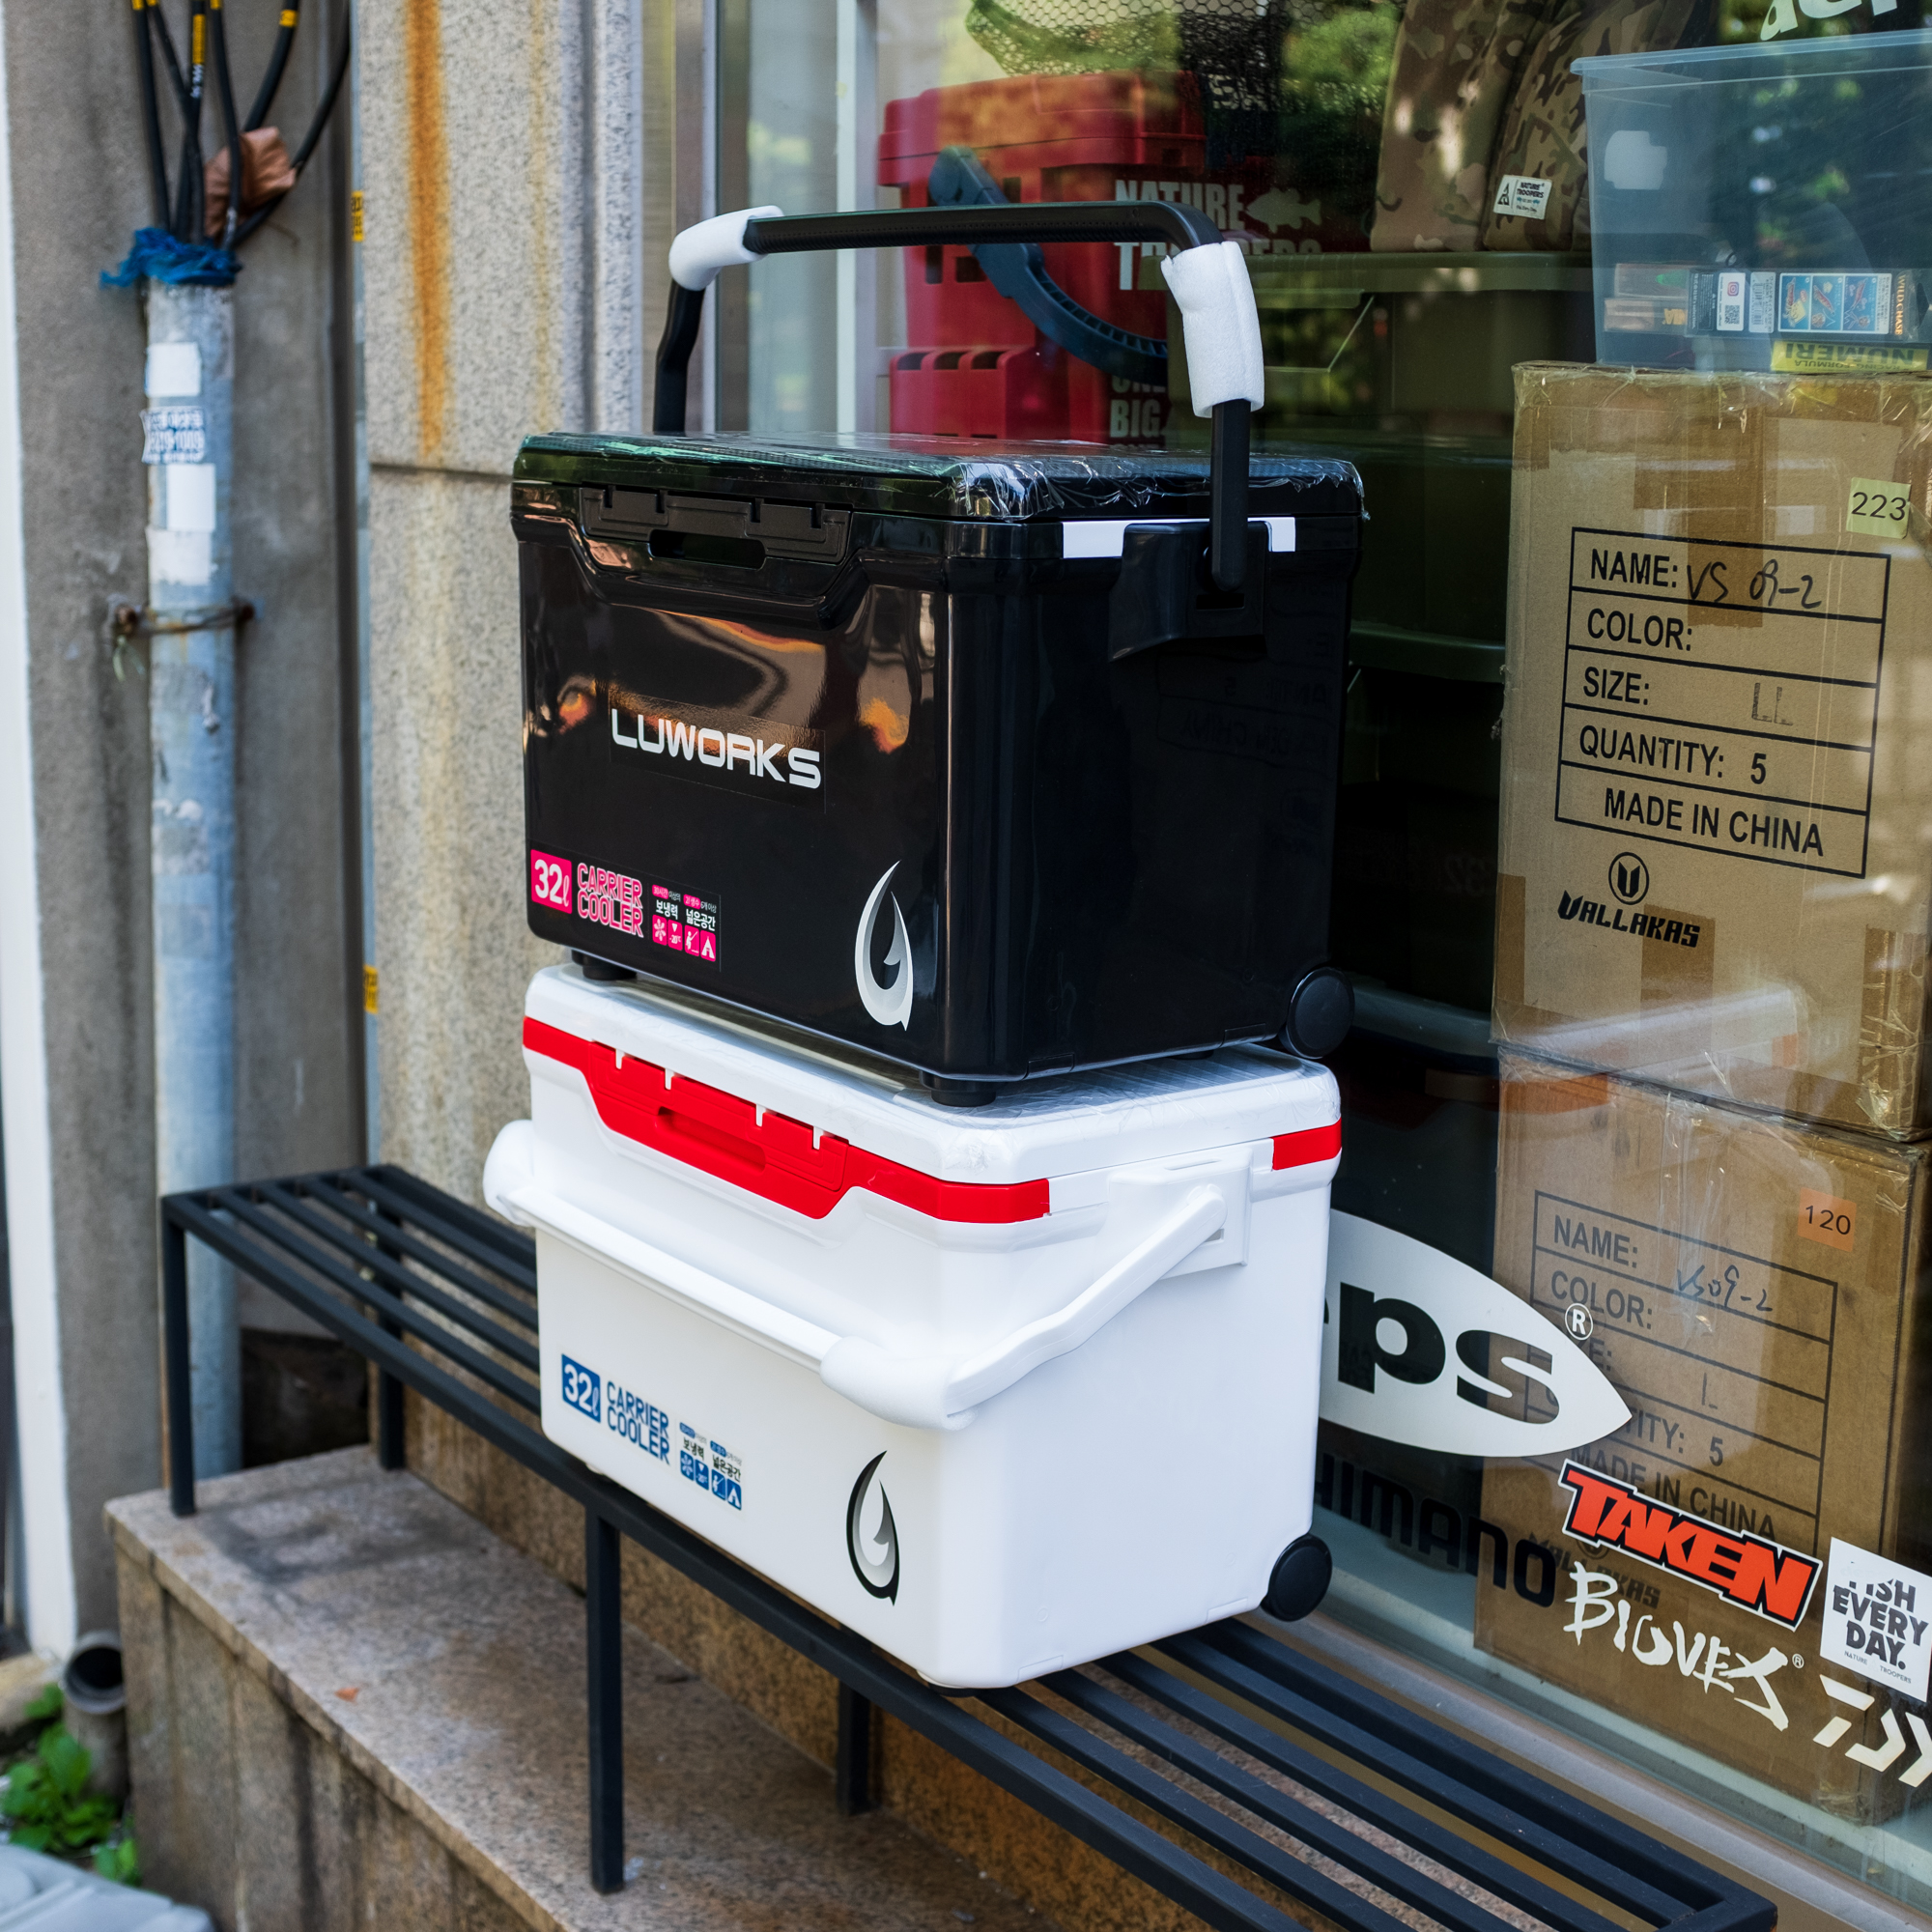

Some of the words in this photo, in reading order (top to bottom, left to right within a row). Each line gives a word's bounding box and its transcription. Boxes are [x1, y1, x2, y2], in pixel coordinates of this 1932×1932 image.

[1852, 492, 1906, 521] 223
[1591, 548, 1678, 588] NAME:
[1587, 608, 1692, 651] COLOR:
[1583, 667, 1650, 706] SIZE:
[611, 708, 821, 789] LUWORKS
[1579, 725, 1724, 779] QUANTITY:
[1749, 753, 1767, 784] 5
[1605, 787, 1684, 832] MADE
[1692, 804, 1719, 838] IN
[1729, 810, 1824, 857] CHINA
[577, 862, 643, 909] CARRIER
[656, 899, 678, 921] 보냉력
[577, 890, 644, 938] COOLER
[1553, 1214, 1638, 1269] NAME:
[1804, 1205, 1852, 1236] 120
[1550, 1270, 1653, 1329] COLOR:
[1323, 1282, 1560, 1425] ps
[607, 1381, 669, 1439] CARRIER
[607, 1406, 670, 1465] COOLER
[1709, 1436, 1723, 1466] 5
[1656, 1471, 1681, 1507] IN
[1690, 1487, 1776, 1538] CHINA
[1565, 1467, 1814, 1623] TAKEN
[1833, 1584, 1929, 1647] EVERY
[1844, 1650, 1868, 1665] NATURE
[1880, 1664, 1912, 1685] TROOPERS
[1846, 1620, 1907, 1670] DAY.
